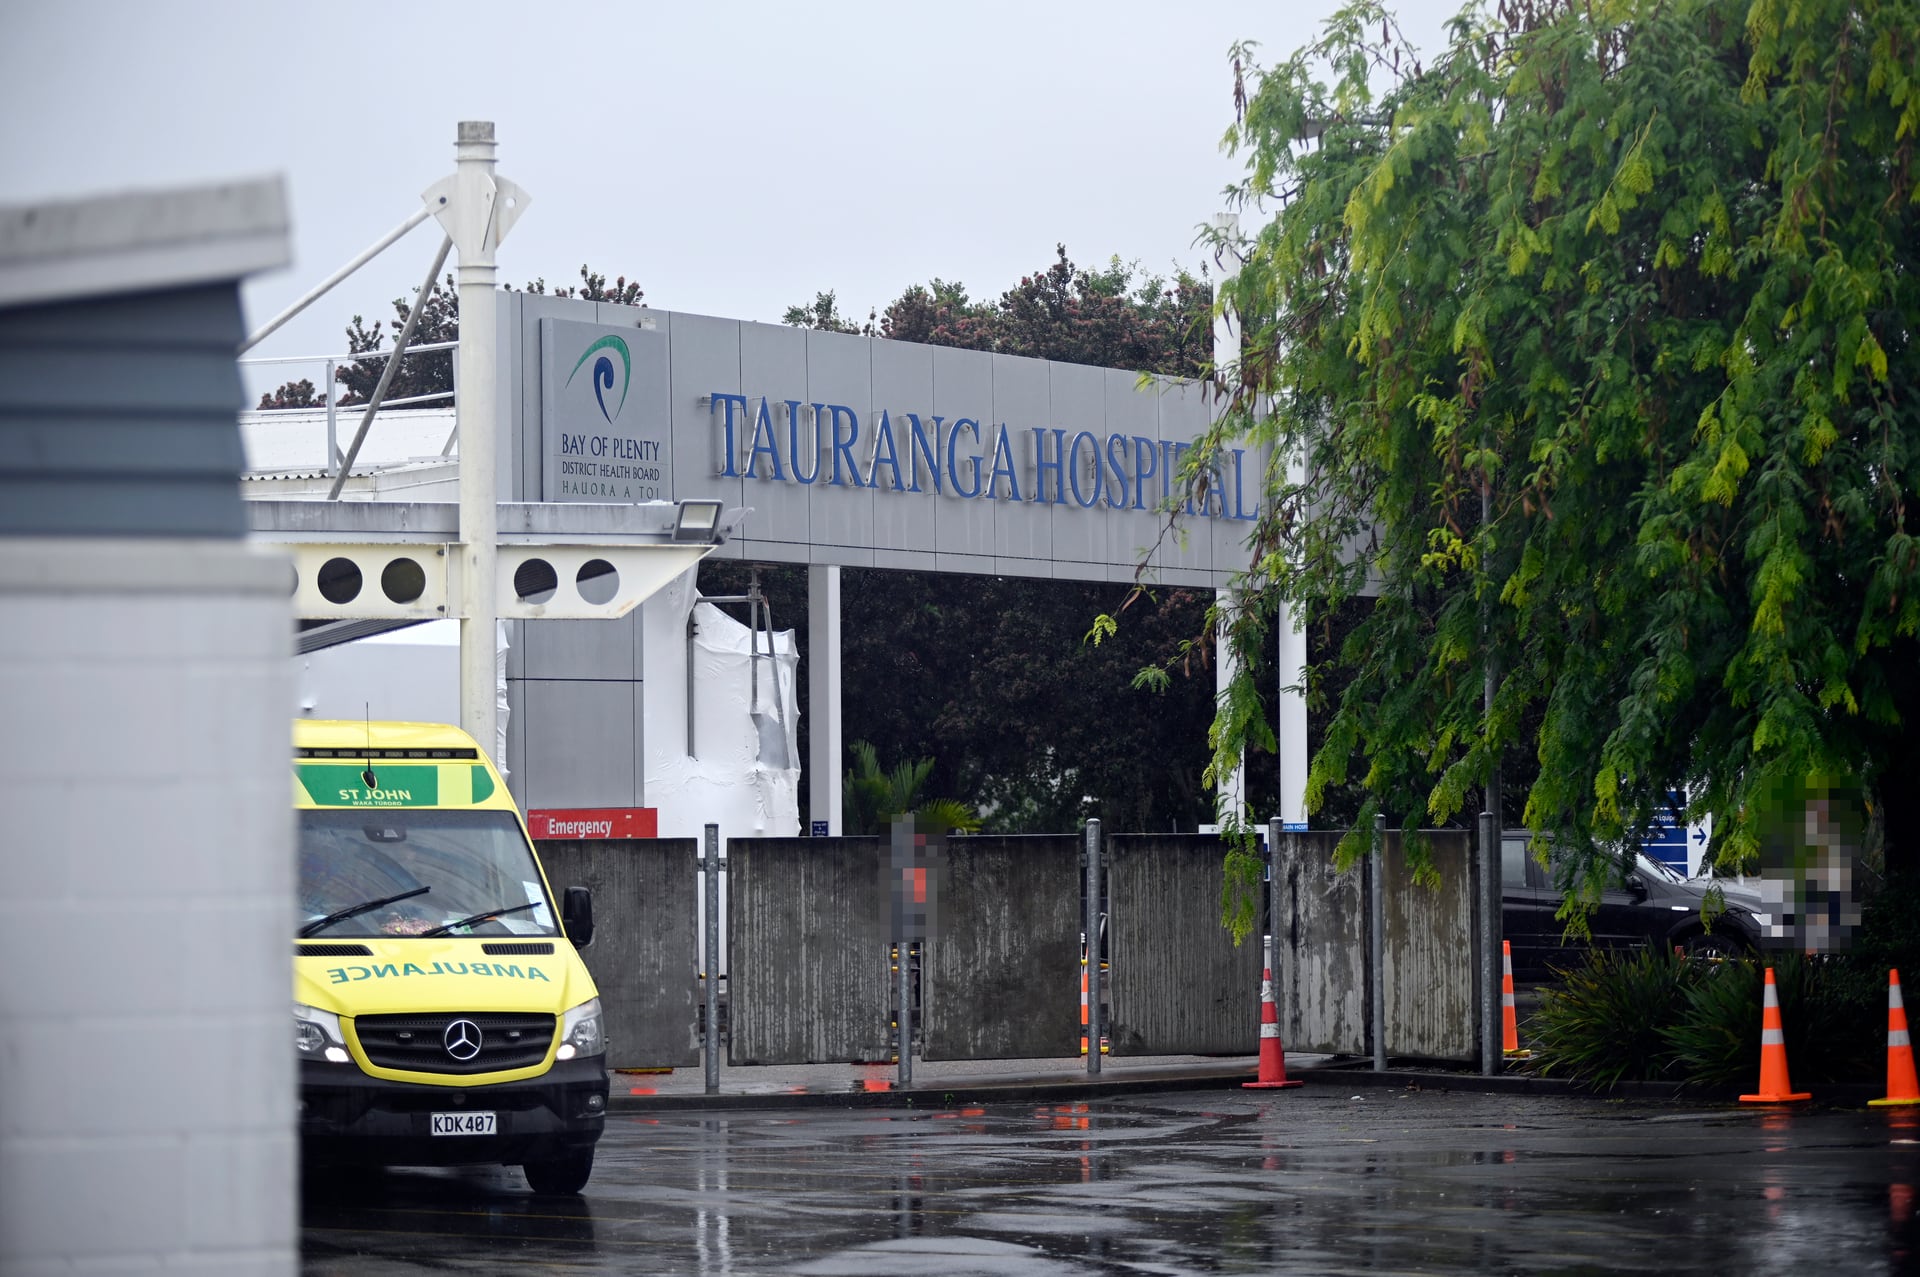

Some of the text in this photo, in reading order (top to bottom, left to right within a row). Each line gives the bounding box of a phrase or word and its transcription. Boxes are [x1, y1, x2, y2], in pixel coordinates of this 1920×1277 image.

[562, 433, 660, 462] BAY OF PLENTY
[711, 392, 1023, 502] TAURANGA
[562, 461, 660, 481] DISTRICT HEALTH BOARD
[562, 480, 660, 500] HAUORA A TOI
[338, 789, 412, 800] ST JOHN
[549, 818, 612, 838] Emergency
[434, 1115, 494, 1133] KDK407
